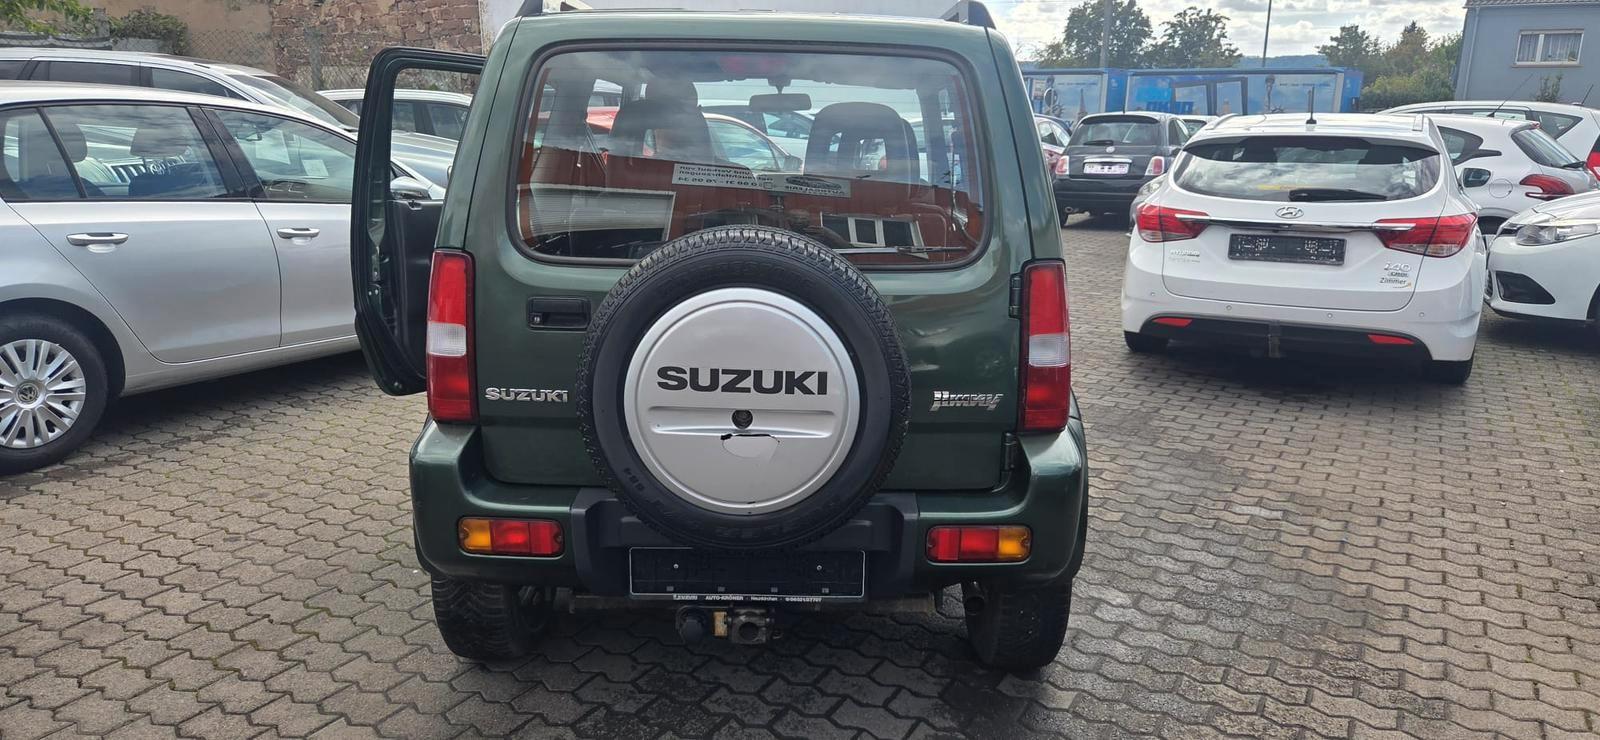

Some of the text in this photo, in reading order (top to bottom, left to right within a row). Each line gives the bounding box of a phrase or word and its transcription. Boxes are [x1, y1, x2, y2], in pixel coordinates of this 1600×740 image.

[1379, 277, 1407, 285] Zimmer
[657, 365, 828, 396] SUZUKI
[485, 387, 569, 403] SUZUKI
